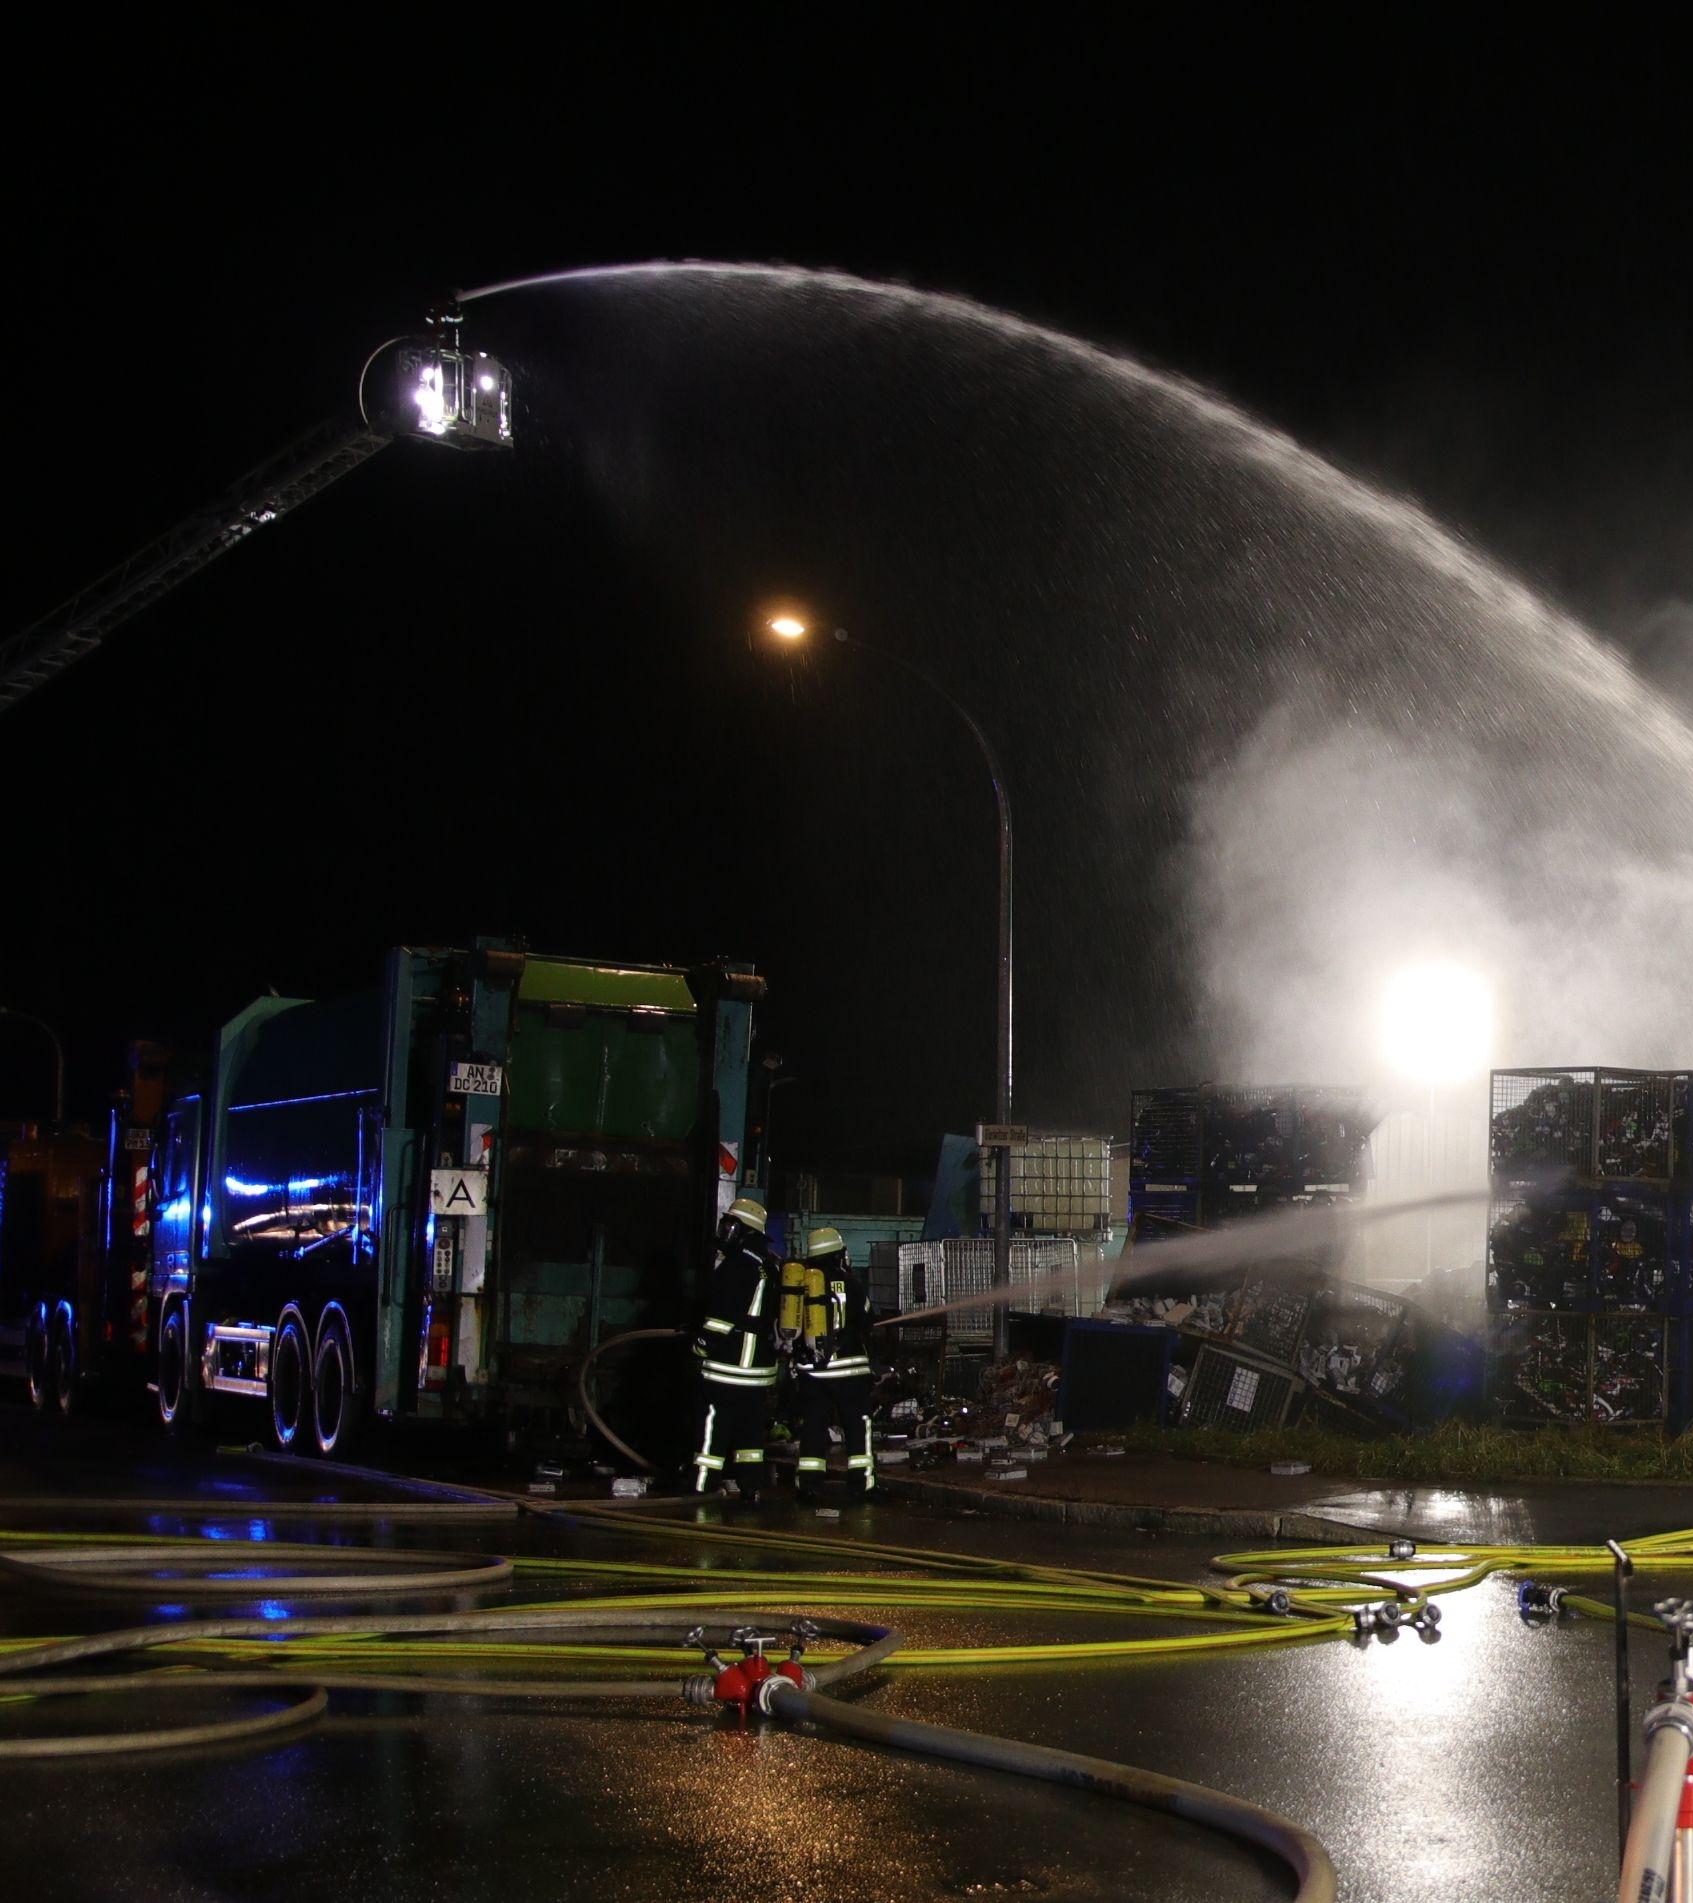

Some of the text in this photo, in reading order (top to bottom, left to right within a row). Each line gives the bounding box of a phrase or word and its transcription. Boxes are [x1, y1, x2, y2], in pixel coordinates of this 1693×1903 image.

[467, 1066, 484, 1079] AN
[454, 1077, 498, 1094] DC 210
[446, 1177, 476, 1208] A
